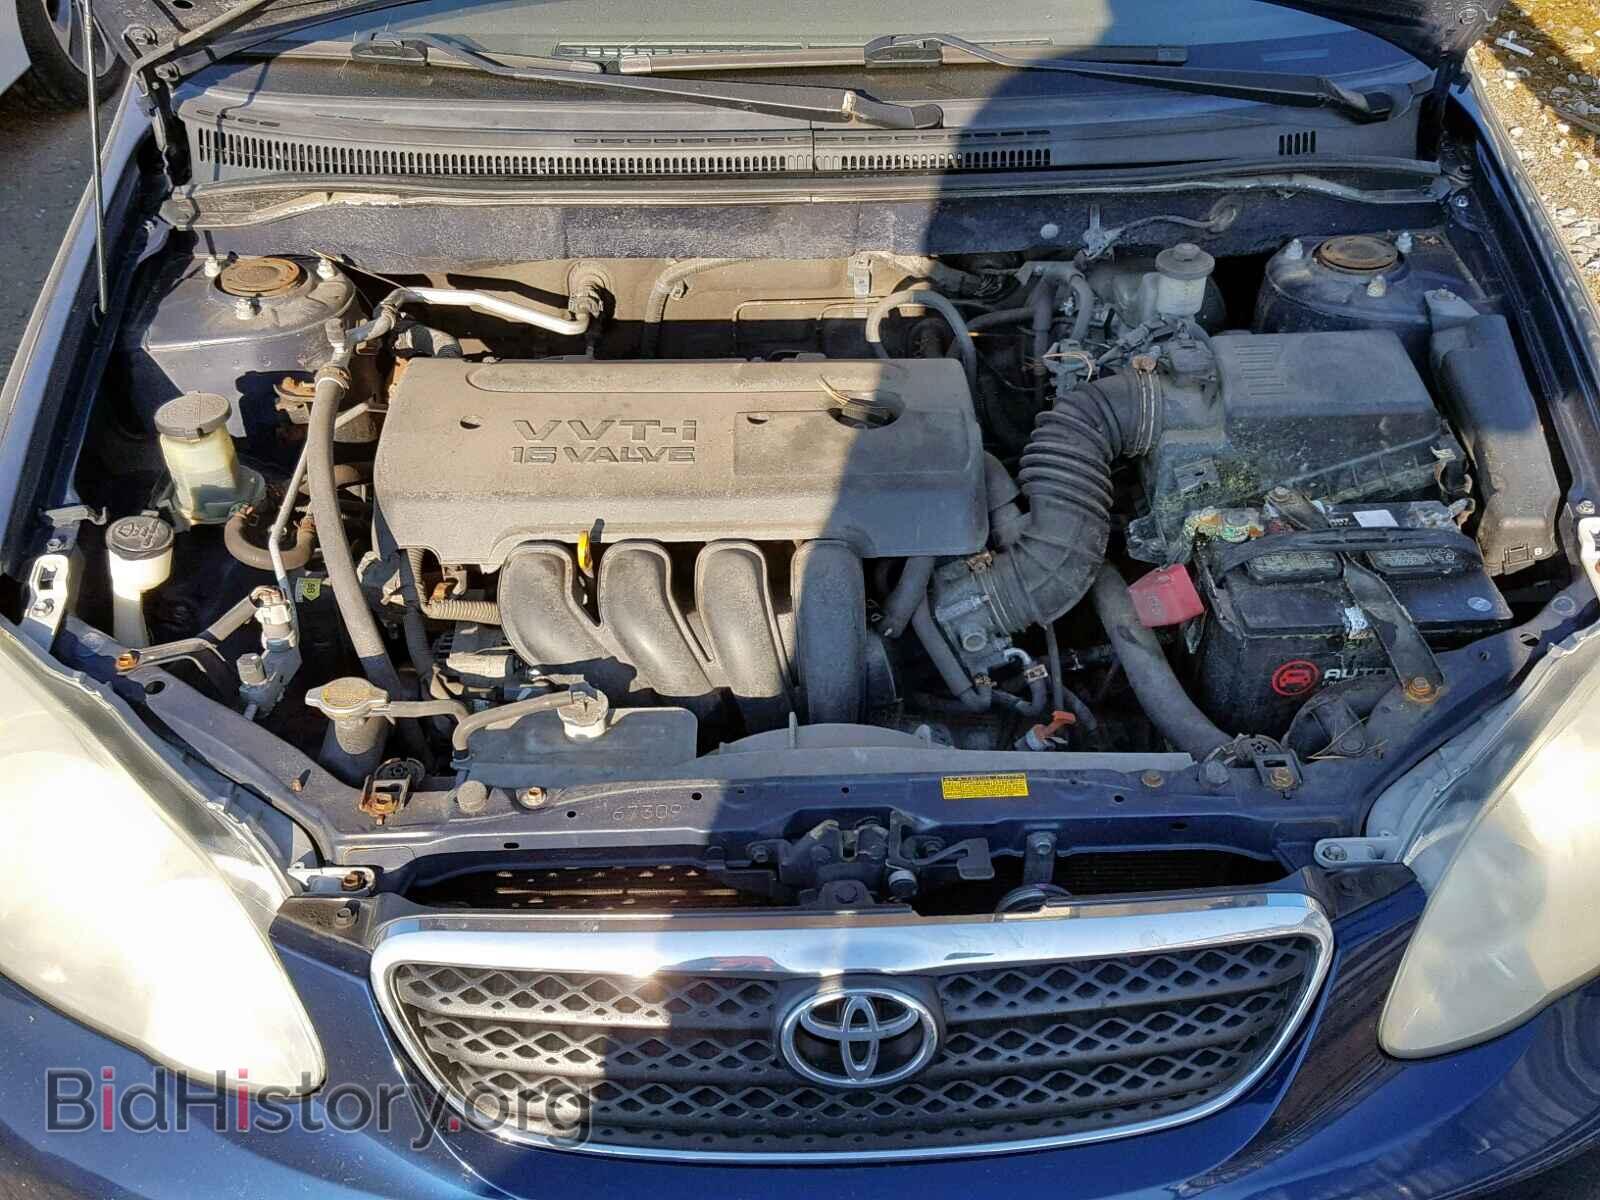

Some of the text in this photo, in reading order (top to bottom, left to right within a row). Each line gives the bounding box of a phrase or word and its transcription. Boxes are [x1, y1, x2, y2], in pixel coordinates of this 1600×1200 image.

[512, 420, 697, 441] VVT-i
[512, 446, 696, 464] 16 VALVE
